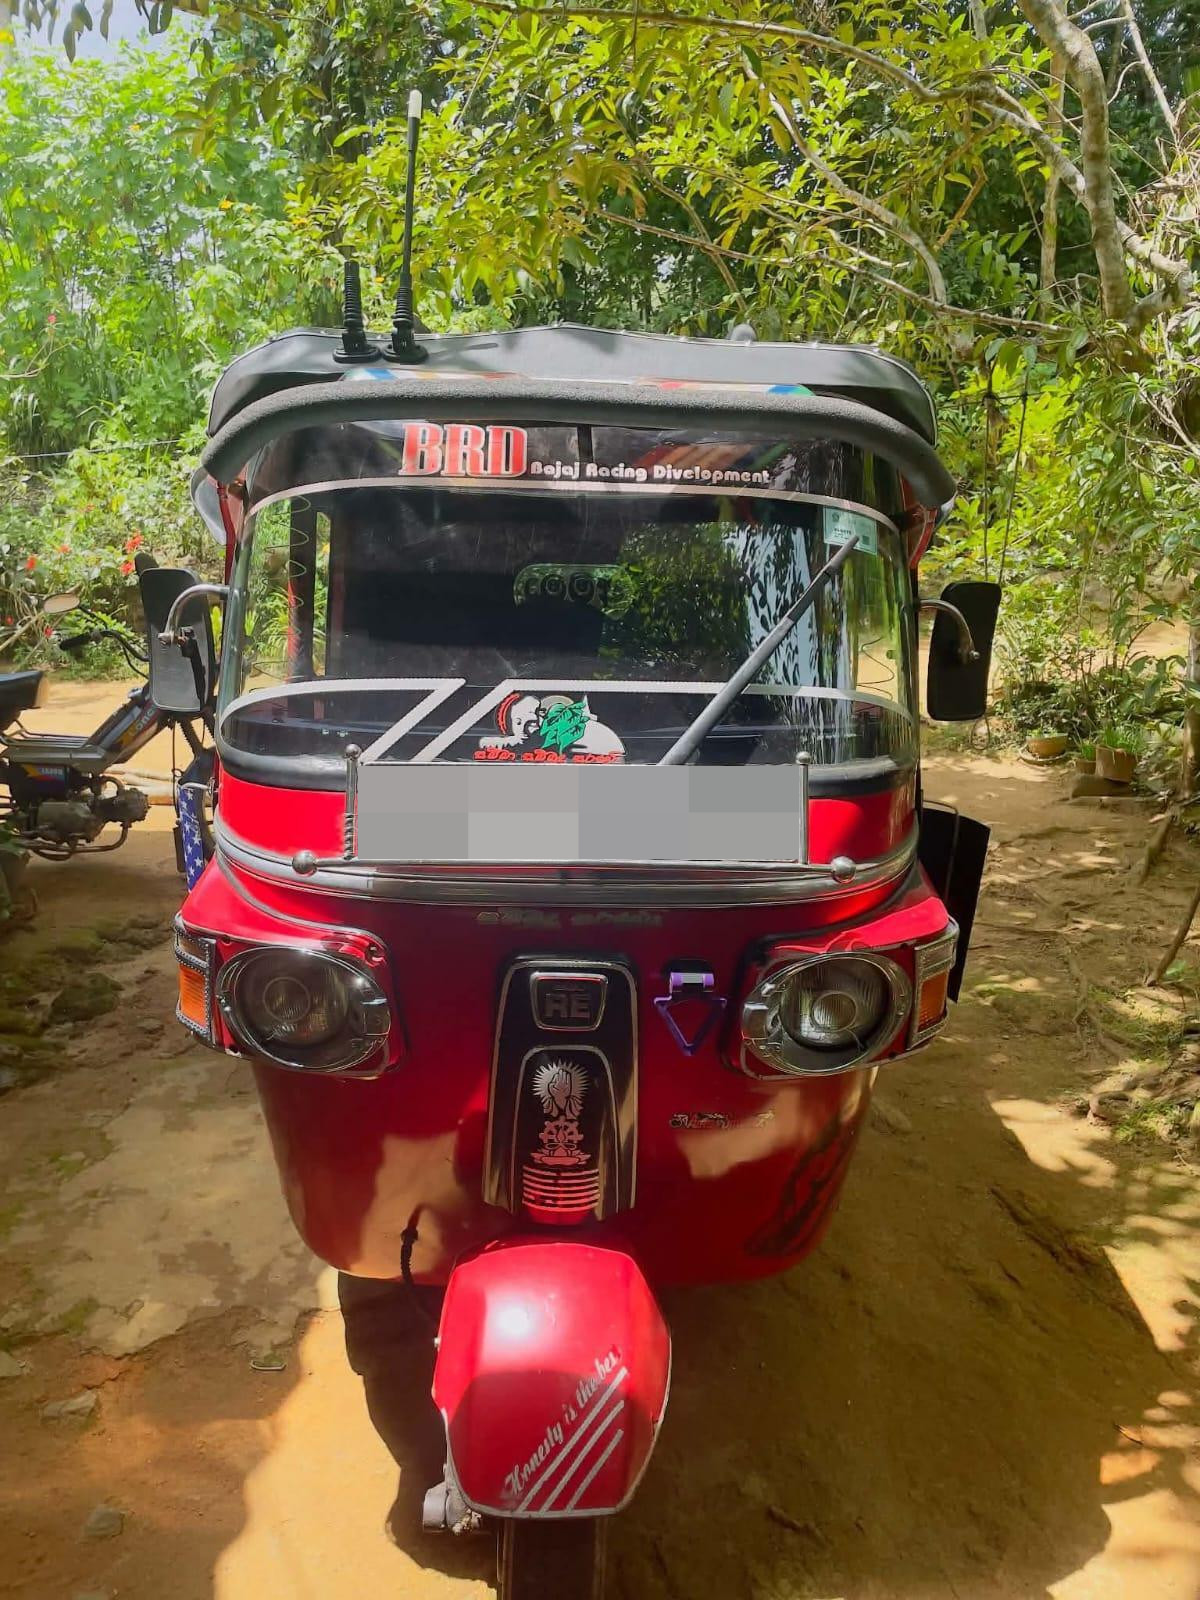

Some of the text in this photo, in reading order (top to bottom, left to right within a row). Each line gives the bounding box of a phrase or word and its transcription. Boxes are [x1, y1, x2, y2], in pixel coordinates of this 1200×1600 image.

[399, 421, 528, 478] BRD
[530, 461, 769, 485] Bajaj Racing Divelopment
[544, 992, 591, 1018] RE
[504, 1422, 565, 1496] Honesty
[562, 1403, 578, 1426] is
[576, 1380, 597, 1409] the
